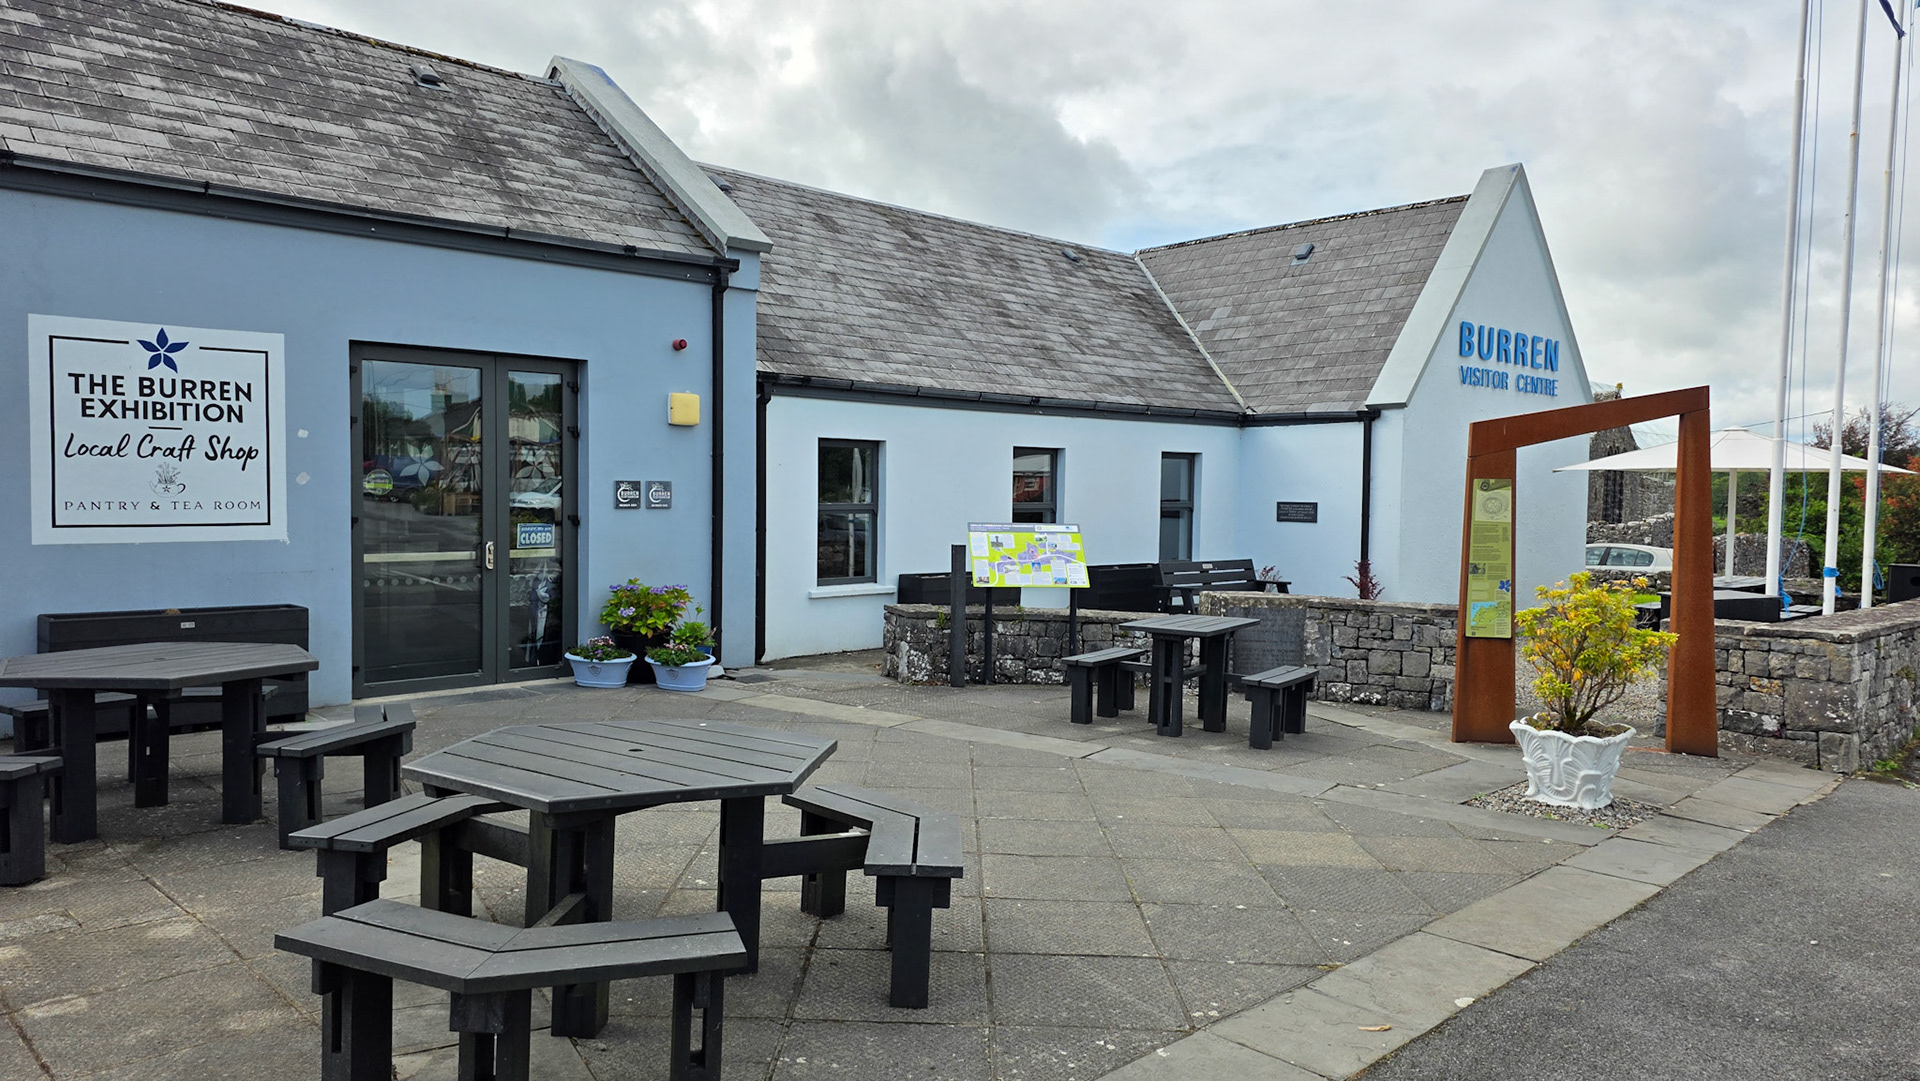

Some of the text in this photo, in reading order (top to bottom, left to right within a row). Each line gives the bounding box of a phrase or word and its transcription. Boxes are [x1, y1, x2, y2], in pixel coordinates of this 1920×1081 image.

[1459, 321, 1559, 372] BURREN
[68, 372, 252, 402] THE BURREN
[1460, 365, 1559, 397] VISITOR CENTRE
[80, 398, 243, 423] EXHIBITION
[64, 432, 259, 471] Local Craft Shop
[64, 500, 261, 511] PANTRY & TEA ROOM
[520, 532, 552, 544] CLOSED
